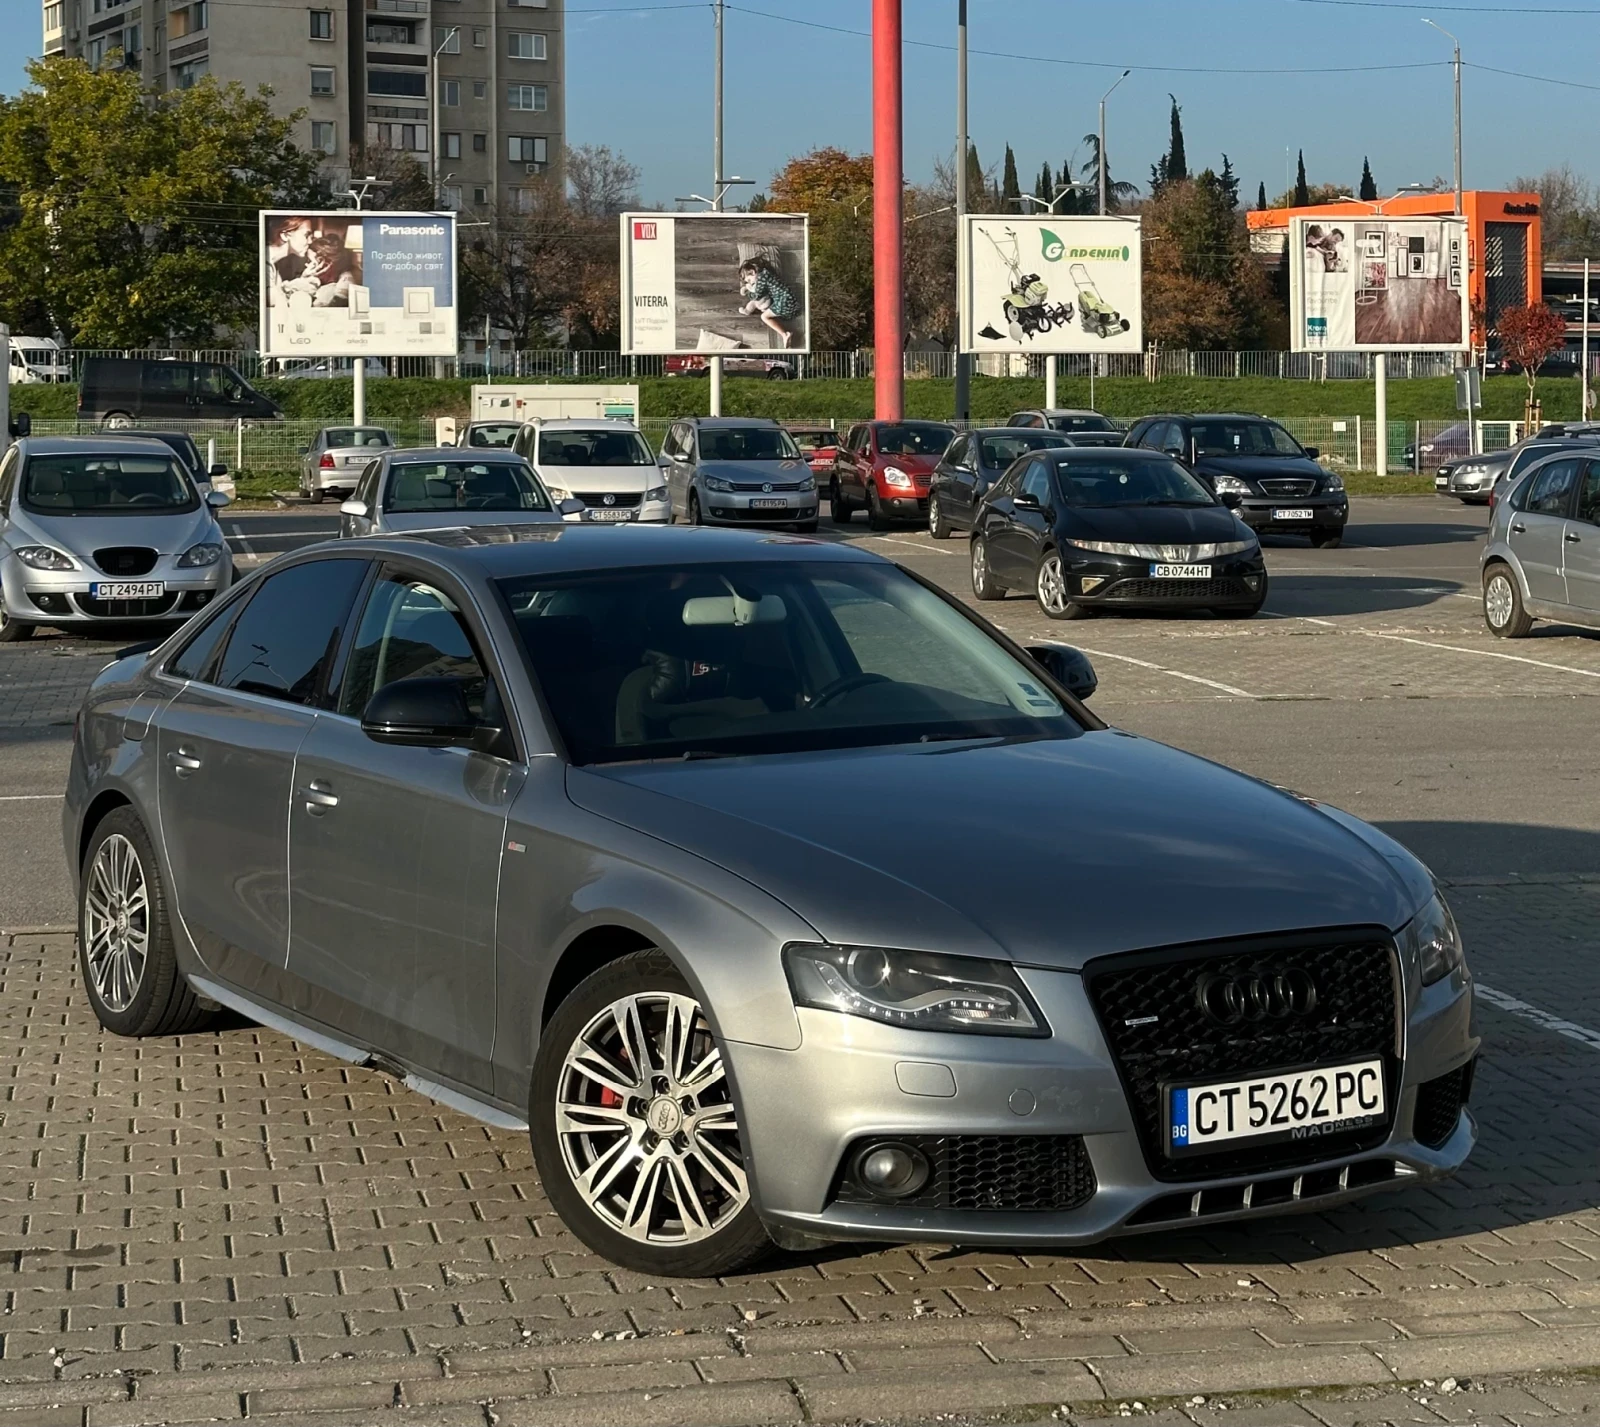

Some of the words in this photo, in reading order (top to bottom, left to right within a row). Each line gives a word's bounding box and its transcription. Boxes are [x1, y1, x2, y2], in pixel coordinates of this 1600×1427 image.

[380, 224, 445, 236] Panasonic
[641, 223, 656, 239] VOX
[371, 250, 413, 261] По-добър
[415, 252, 444, 261] живот,
[1045, 242, 1120, 259] GRDENIA
[381, 261, 422, 271] по-добър
[634, 295, 668, 307] VITERRA
[1156, 566, 1170, 576] CB
[1171, 566, 1195, 576] 0744
[1196, 566, 1209, 576] HT
[100, 584, 115, 596] CT
[116, 584, 144, 596] 2494
[146, 583, 161, 595] PT
[1195, 1086, 1241, 1136] CT
[1248, 1075, 1330, 1128] 5262
[1335, 1068, 1379, 1115] PC
[1172, 1125, 1187, 1139] BG
